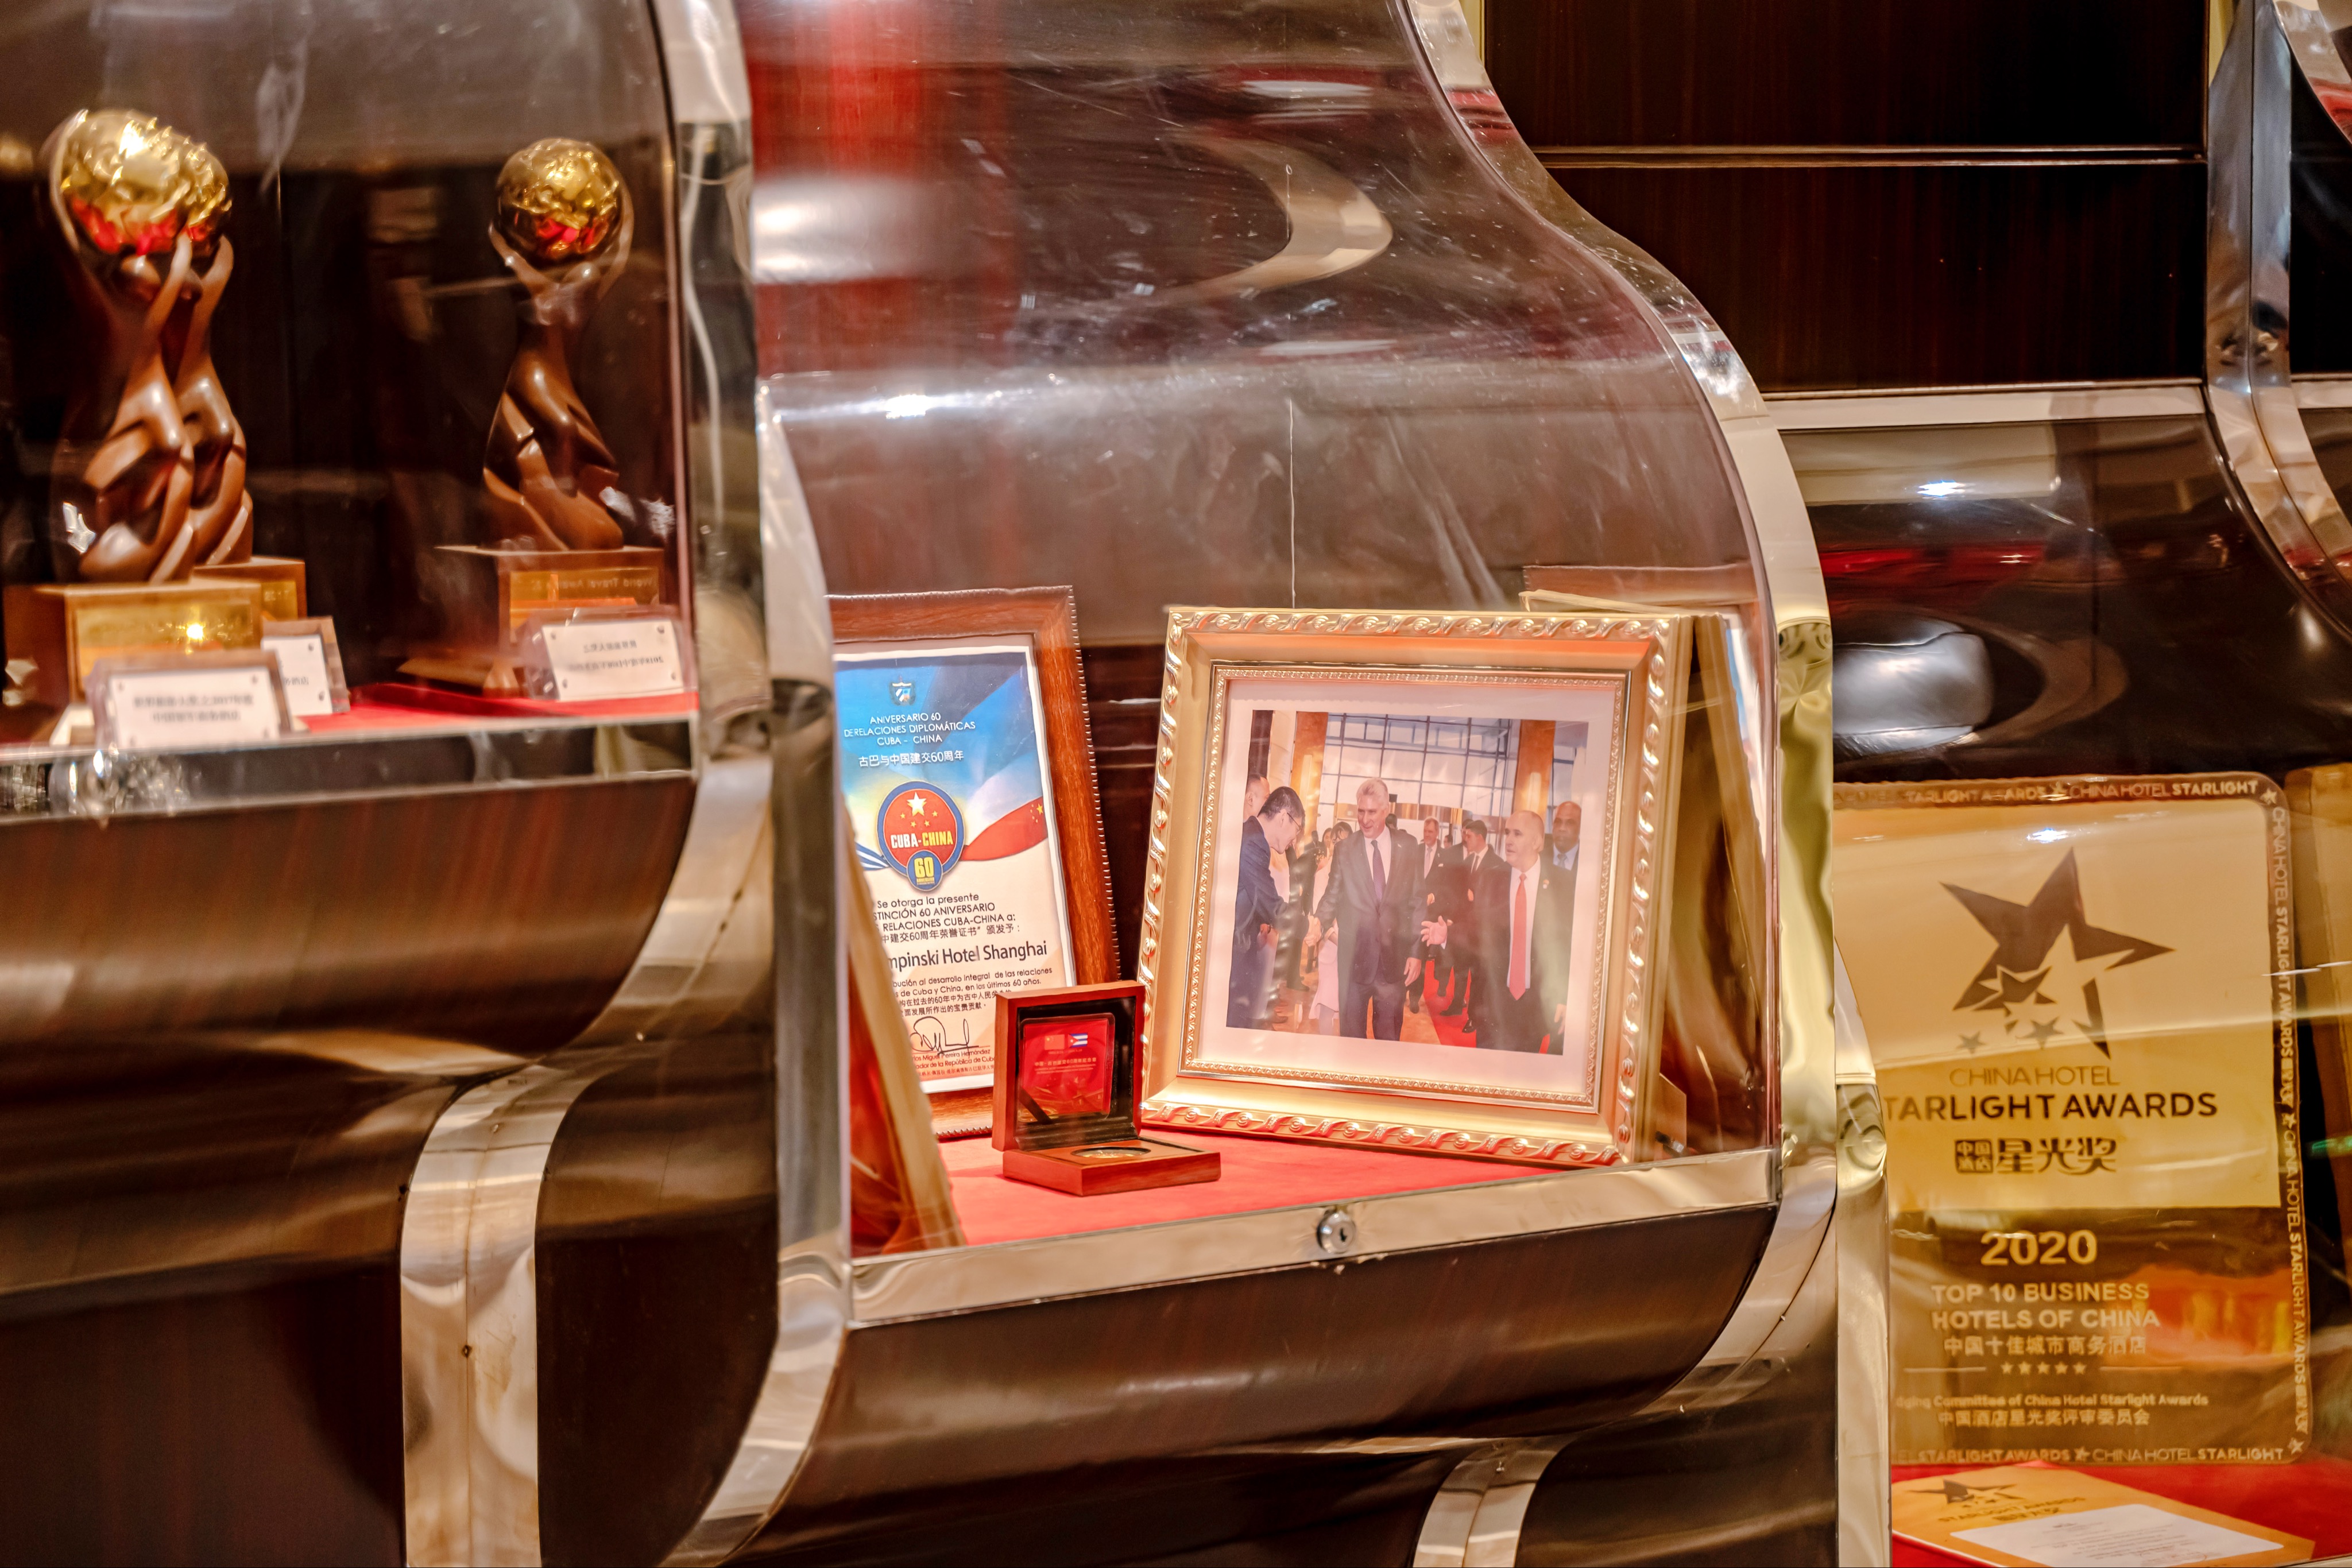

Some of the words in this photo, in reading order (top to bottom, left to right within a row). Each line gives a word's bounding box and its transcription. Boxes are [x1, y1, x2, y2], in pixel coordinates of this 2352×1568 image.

[870, 713, 929, 725] ANIVERSARIO
[931, 712, 941, 721] 60
[844, 729, 853, 737] DE
[854, 725, 907, 737] RELACIONES
[909, 721, 976, 734] DIPLOMÁTICAS
[877, 737, 902, 746] CUBA
[913, 734, 943, 744] CHINA
[858, 750, 964, 768] 古巴与中国建交60周年
[2171, 780, 2258, 797] STARLIGHT
[890, 830, 954, 849] CUBA-CHINA
[914, 857, 935, 878] 60
[877, 900, 888, 909] Se
[891, 899, 923, 908] otorga
[926, 896, 935, 905] la
[938, 893, 979, 905] presente
[919, 908, 931, 917] 60
[933, 902, 995, 916] ANIVERSARIO
[883, 918, 941, 932] RELACIONES
[943, 914, 1004, 927] CUBA-CHINA
[1007, 913, 1015, 922] a:
[942, 945, 980, 964] Hotel
[983, 940, 1047, 961] Shanghai
[919, 978, 926, 986] al
[928, 975, 962, 985] desarrollo
[964, 971, 991, 981] integral
[1017, 967, 1053, 976] relaciones
[900, 989, 910, 997] de
[940, 985, 963, 993] China,
[987, 981, 1011, 989] últimos
[1949, 1066, 2032, 1088] CHINA
[2034, 1065, 2121, 1086] HOTEL
[2061, 1092, 2218, 1120] AWARDS
[1980, 1229, 2098, 1265] 2020
[1930, 1284, 1983, 1304] TOP
[1989, 1283, 2016, 1303] 10
[2024, 1281, 2149, 1303] BUSINESS
[1931, 1310, 2033, 1330] HOTELS
[2038, 1309, 2072, 1329] OF
[2080, 1308, 2161, 1329] CHINA
[2008, 1393, 2023, 1407] of
[2025, 1393, 2061, 1407] China
[2099, 1392, 2156, 1407] Starlight
[2158, 1393, 2209, 1406] Awards
[2198, 1447, 2284, 1462] STARLIGHT
